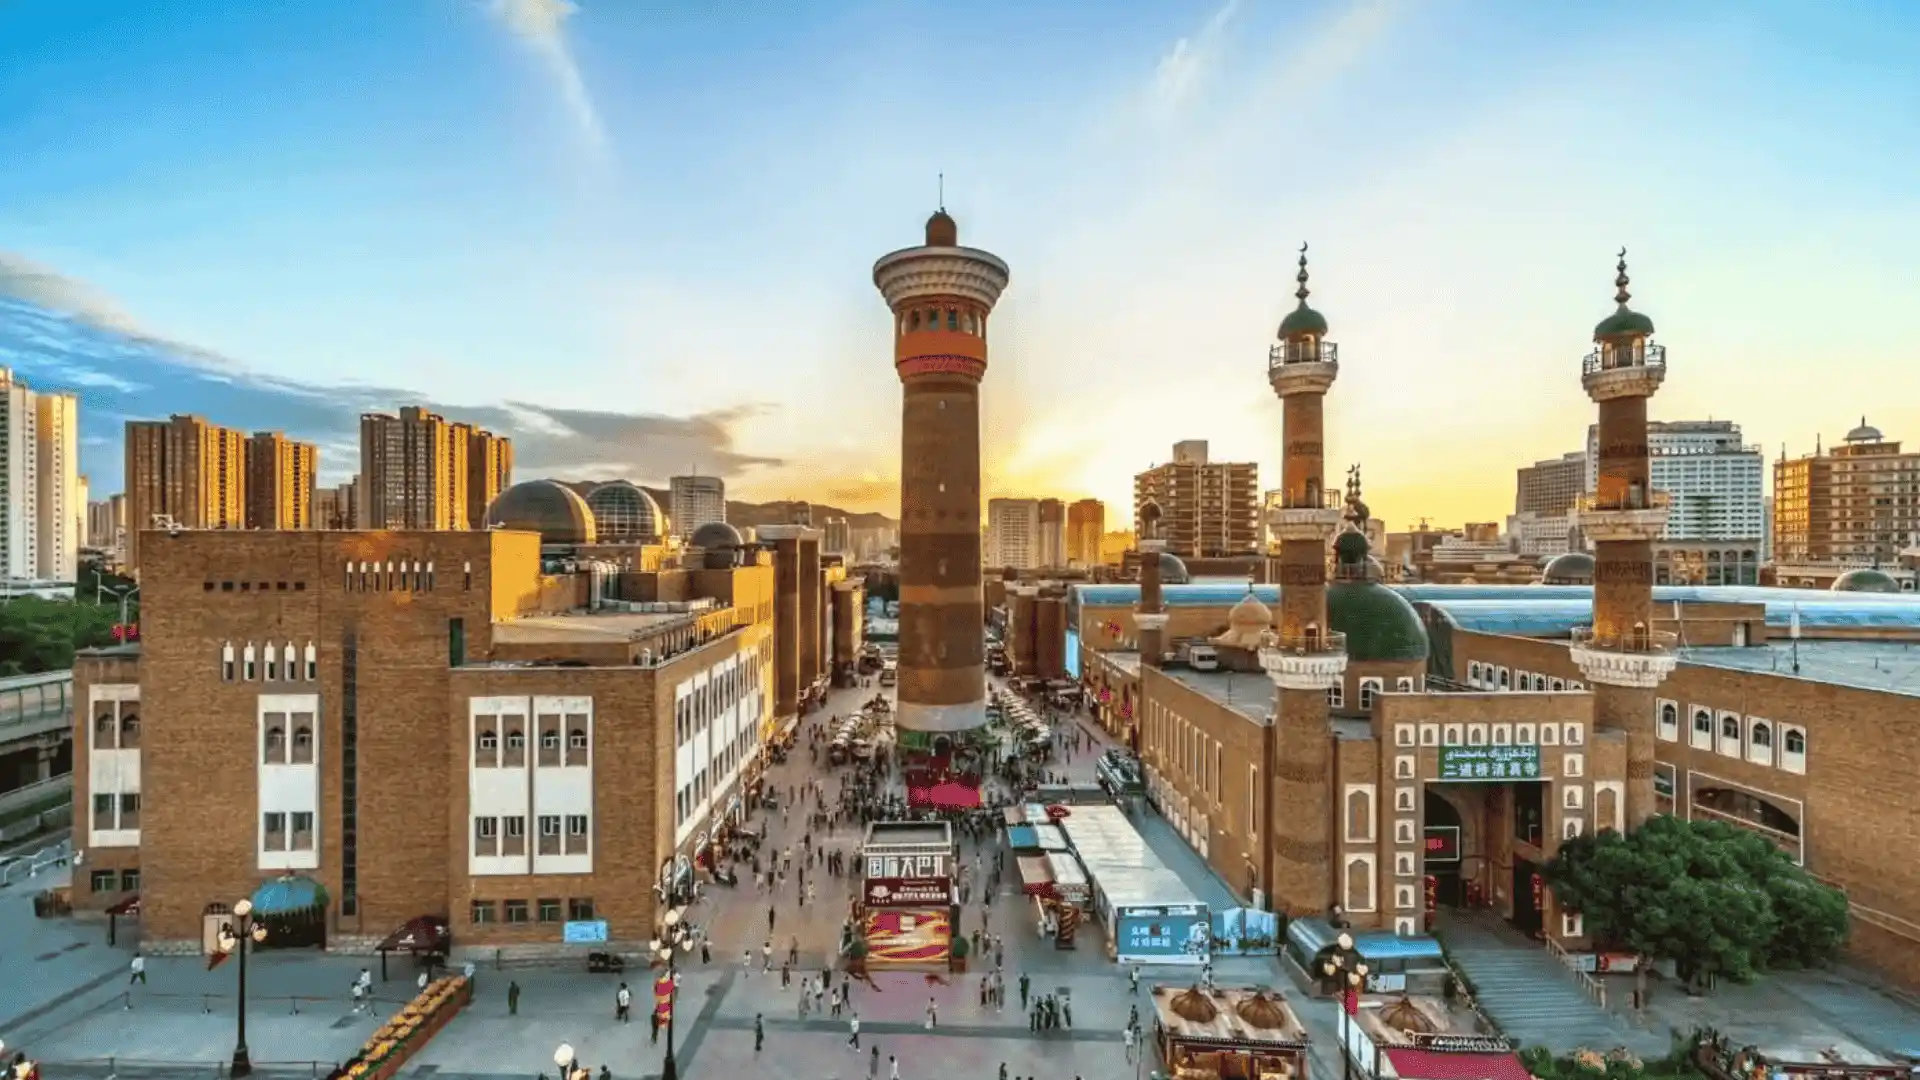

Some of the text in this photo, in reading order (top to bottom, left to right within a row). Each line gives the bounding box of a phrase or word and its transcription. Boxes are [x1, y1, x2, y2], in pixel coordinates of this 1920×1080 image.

[1443, 762, 1537, 777] 二道桥清真寺
[868, 856, 947, 878] 国际大巴扎
